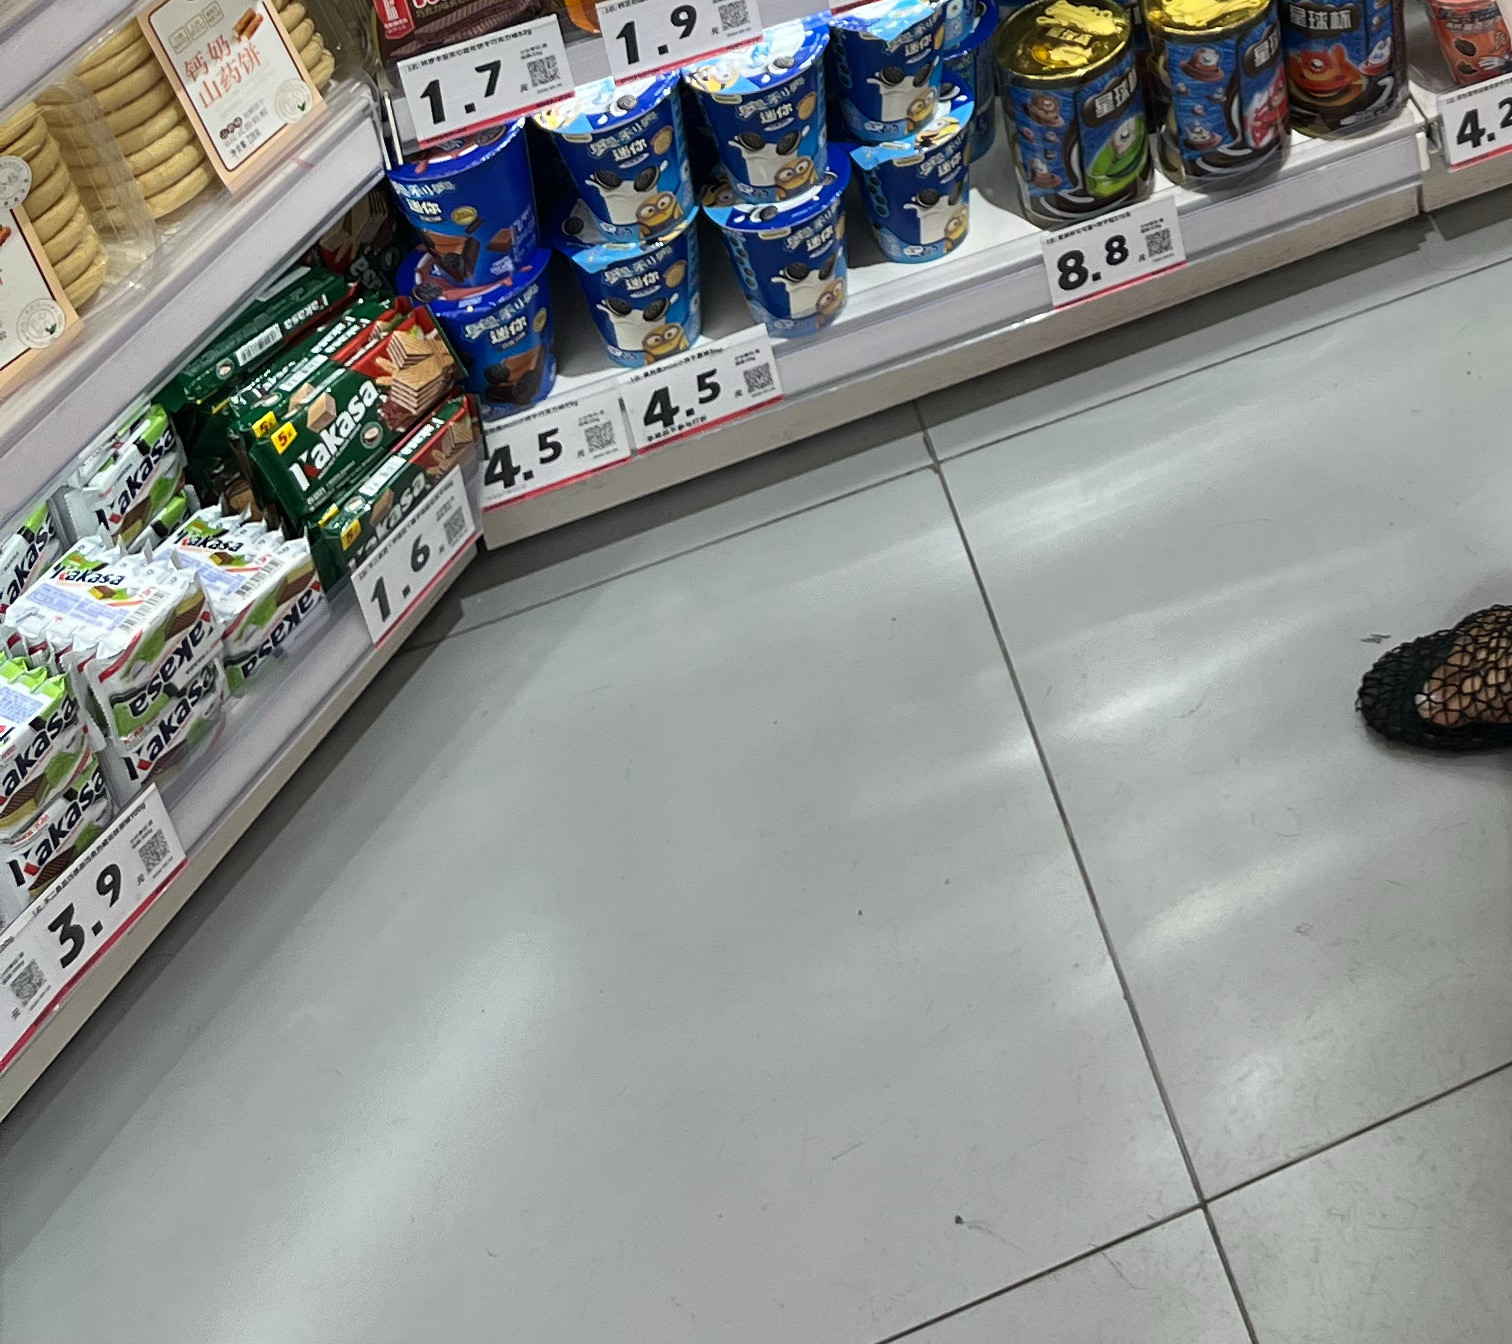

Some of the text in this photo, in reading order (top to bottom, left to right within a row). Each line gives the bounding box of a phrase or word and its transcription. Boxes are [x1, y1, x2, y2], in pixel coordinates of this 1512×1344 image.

[616, 5, 697, 65] 1.9
[1290, 3, 1351, 32] 星球杯
[184, 34, 231, 84] 钙奶
[199, 46, 262, 109] 山药饼
[419, 61, 502, 124] 1.7
[1057, 234, 1130, 291] 8.8
[643, 368, 722, 429] 4.5
[289, 379, 381, 492] Kakasa
[484, 428, 563, 490] 4.5
[370, 534, 432, 623] 1.6
[122, 660, 215, 780] Kakasa
[48, 864, 122, 969] 3.9
